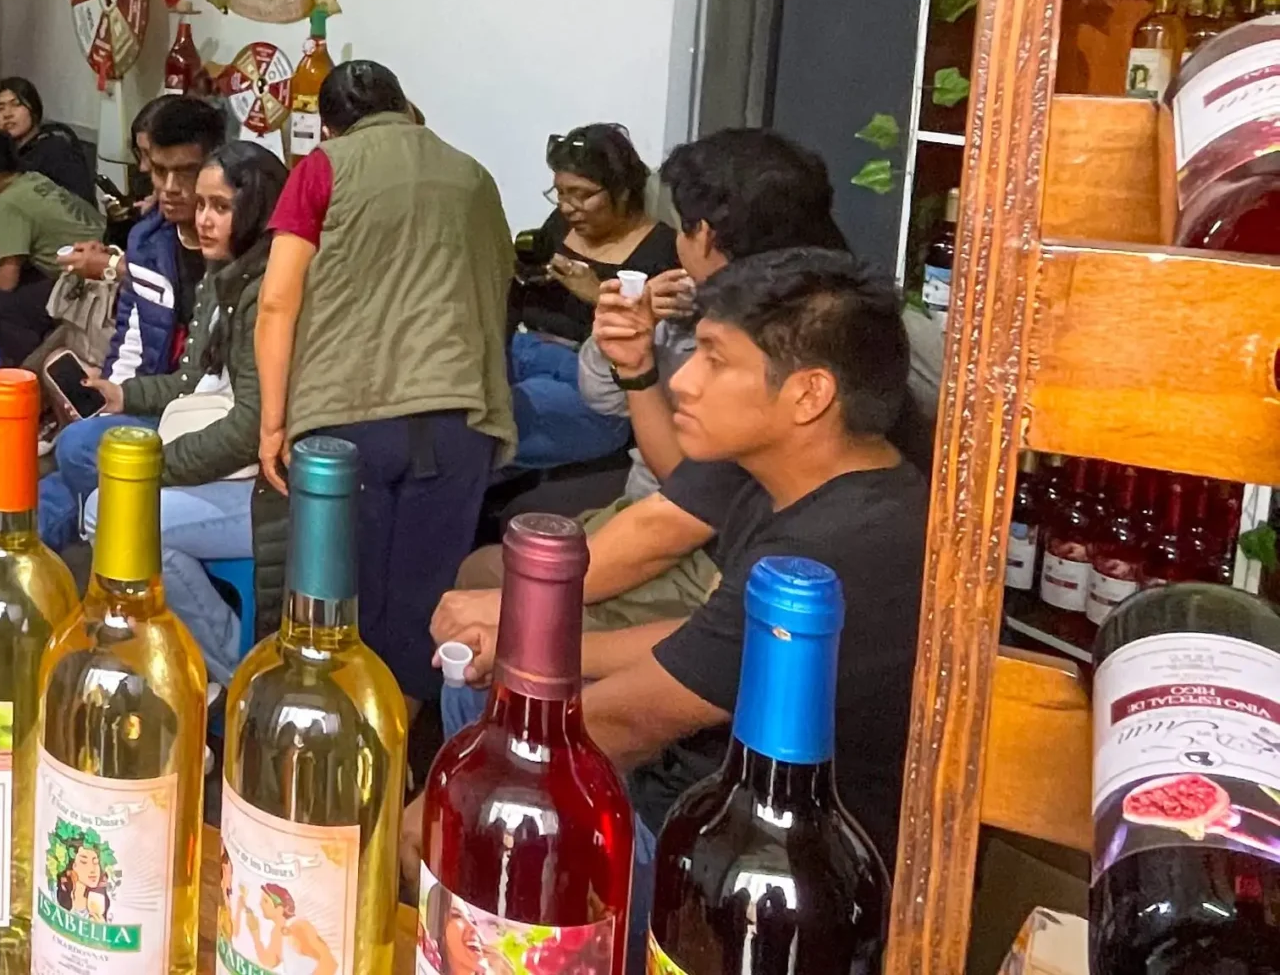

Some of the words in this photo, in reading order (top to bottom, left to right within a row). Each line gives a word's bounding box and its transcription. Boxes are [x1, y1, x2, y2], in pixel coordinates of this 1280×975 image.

[1170, 685, 1217, 695] HIGO
[1147, 693, 1222, 708] ESPECIAL
[1223, 697, 1272, 719] VINO
[40, 893, 132, 944] ISABELLA
